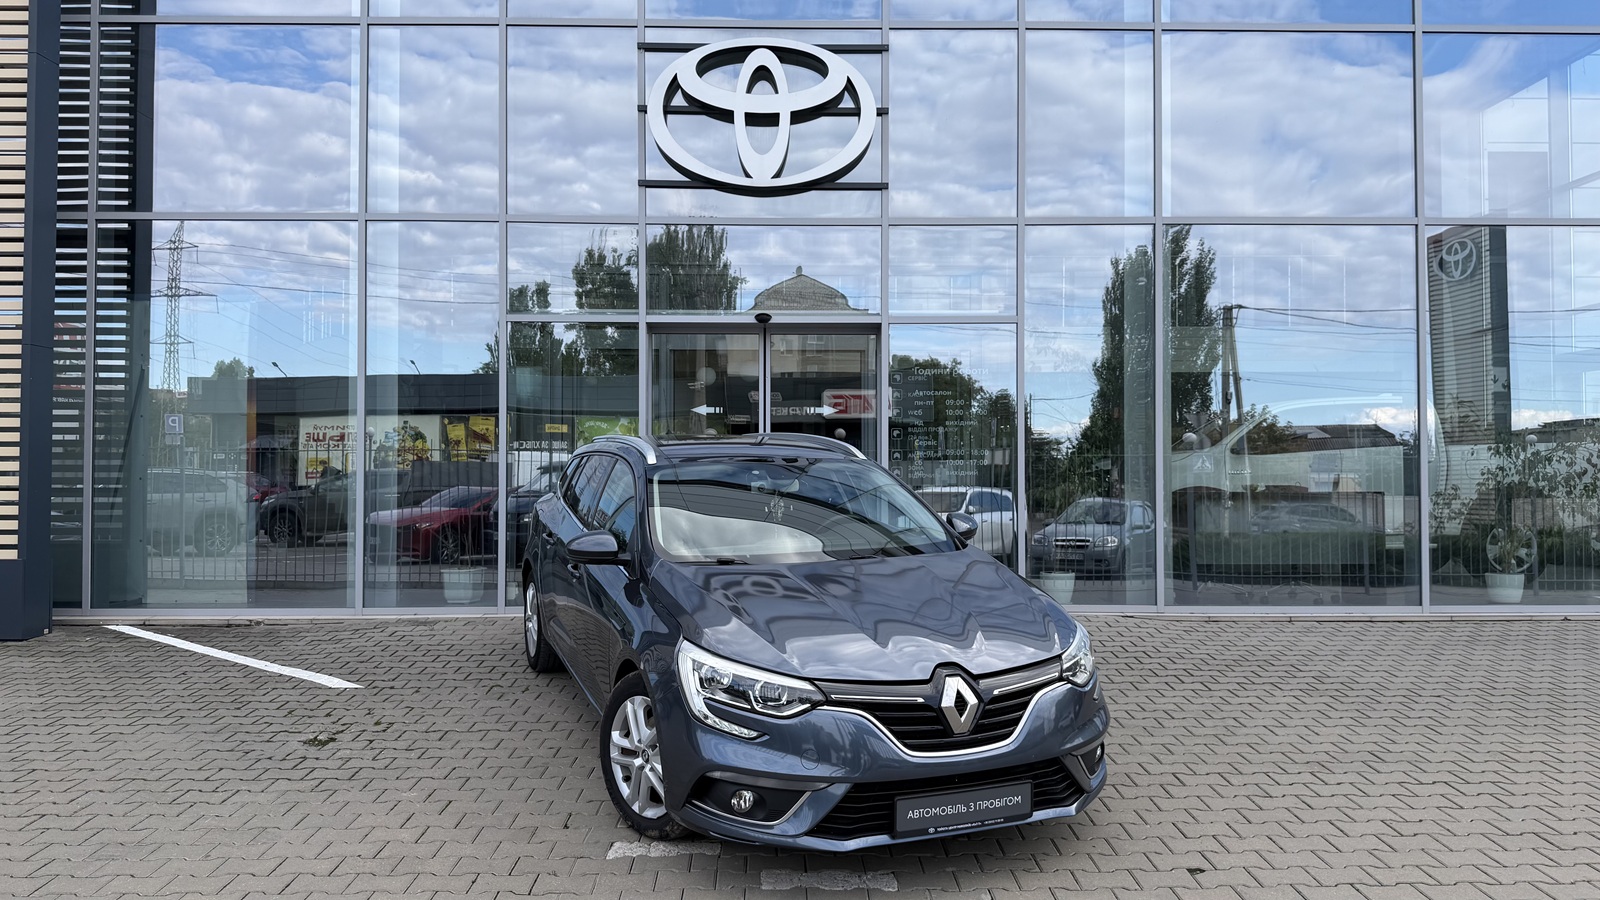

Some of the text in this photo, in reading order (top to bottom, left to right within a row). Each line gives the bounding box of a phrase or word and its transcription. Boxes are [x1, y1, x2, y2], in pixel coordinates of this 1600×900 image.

[914, 367, 950, 376] Години
[907, 796, 1022, 819] АВТОМОБІЛЬ З ПРОБІГОМ
